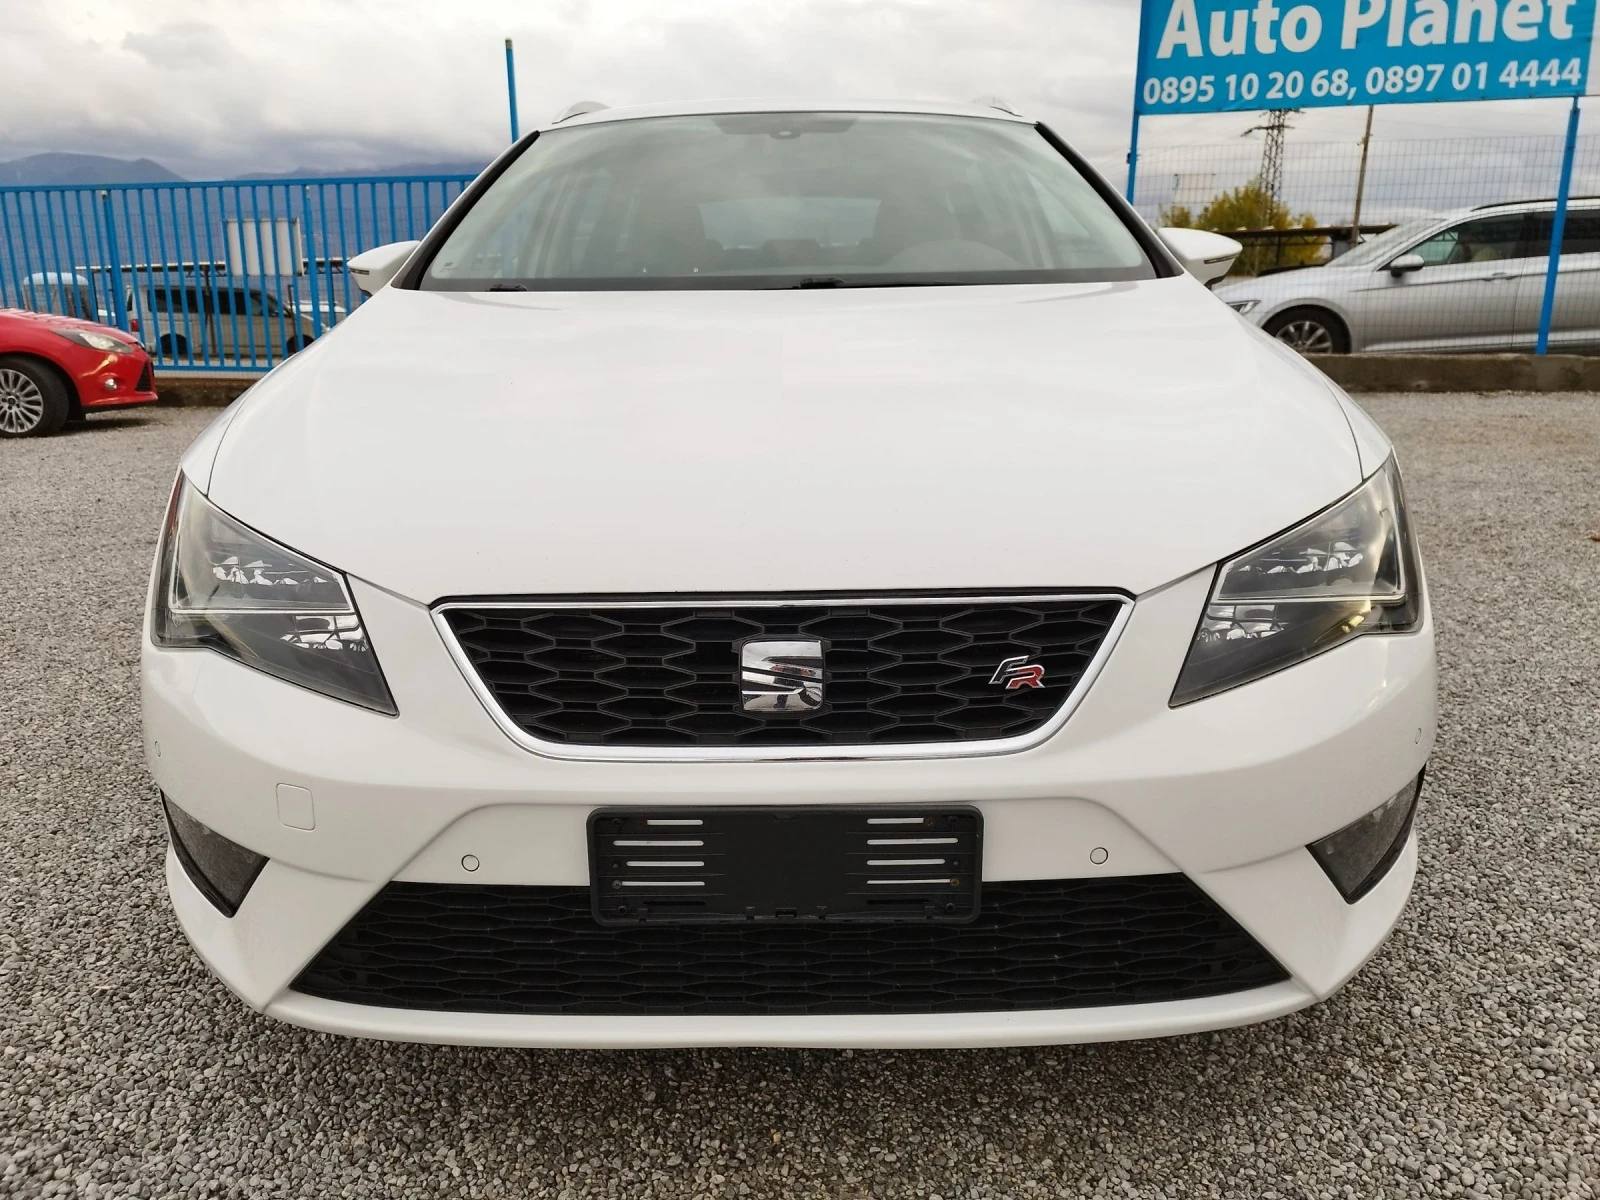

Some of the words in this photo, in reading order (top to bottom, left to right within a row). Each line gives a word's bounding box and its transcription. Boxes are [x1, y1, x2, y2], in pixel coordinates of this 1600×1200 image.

[1155, 0, 1323, 59] Auto
[1341, 0, 1577, 50] Planet
[1143, 75, 1215, 105] 0895
[1225, 72, 1260, 101] 10
[1265, 70, 1304, 100] 20
[1311, 68, 1357, 100] 68,
[1365, 63, 1445, 95] 0897
[1452, 62, 1488, 91] 01
[1499, 58, 1582, 88] 4444
[988, 654, 1046, 690] FR
